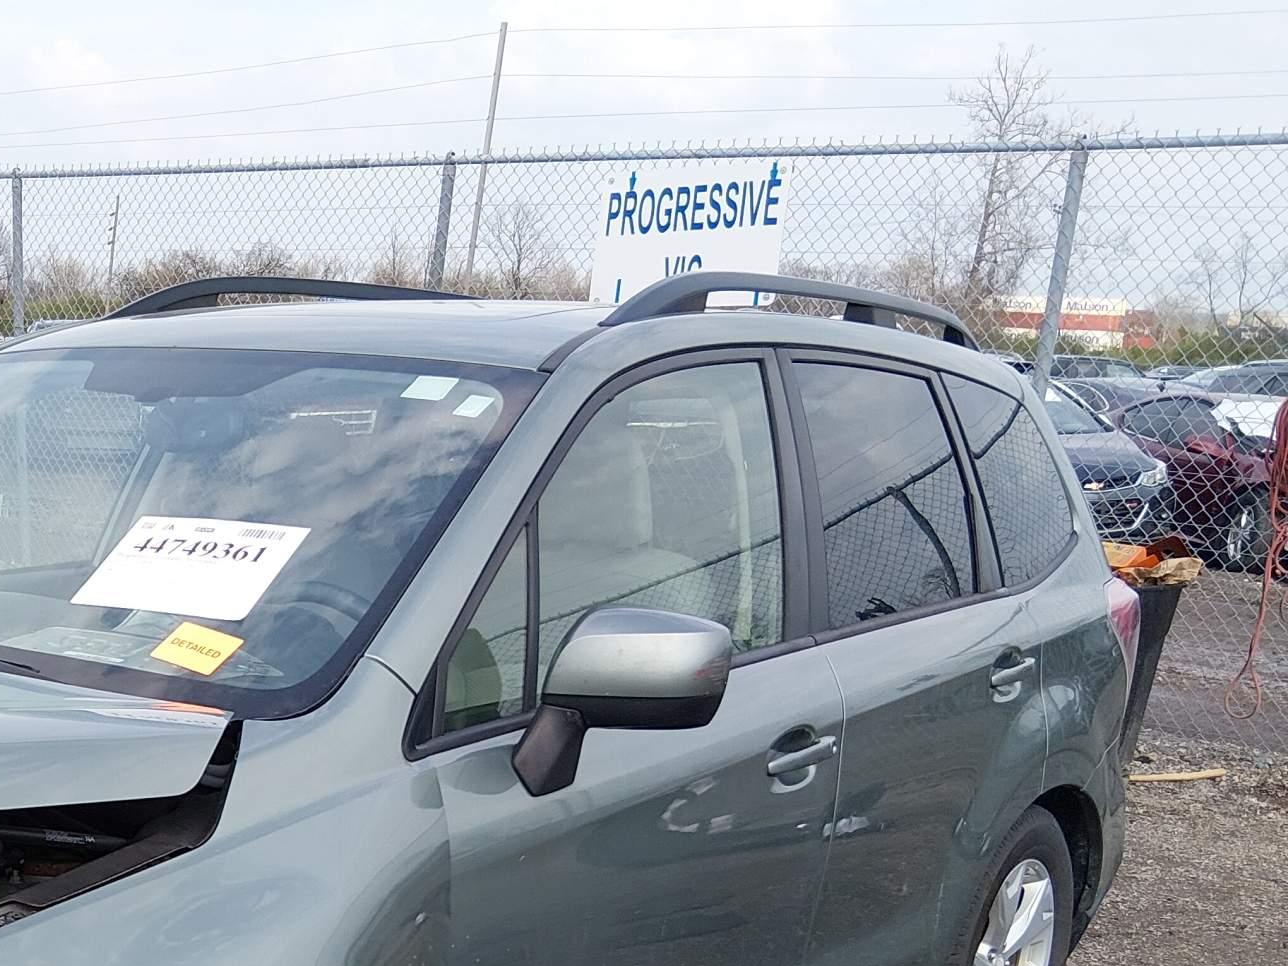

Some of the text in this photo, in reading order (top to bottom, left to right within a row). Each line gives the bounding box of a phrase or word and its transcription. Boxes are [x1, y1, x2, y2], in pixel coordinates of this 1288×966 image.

[605, 178, 782, 237] PROGRESSIVE
[133, 536, 268, 563] 44749361
[170, 637, 221, 660] DETAILED
